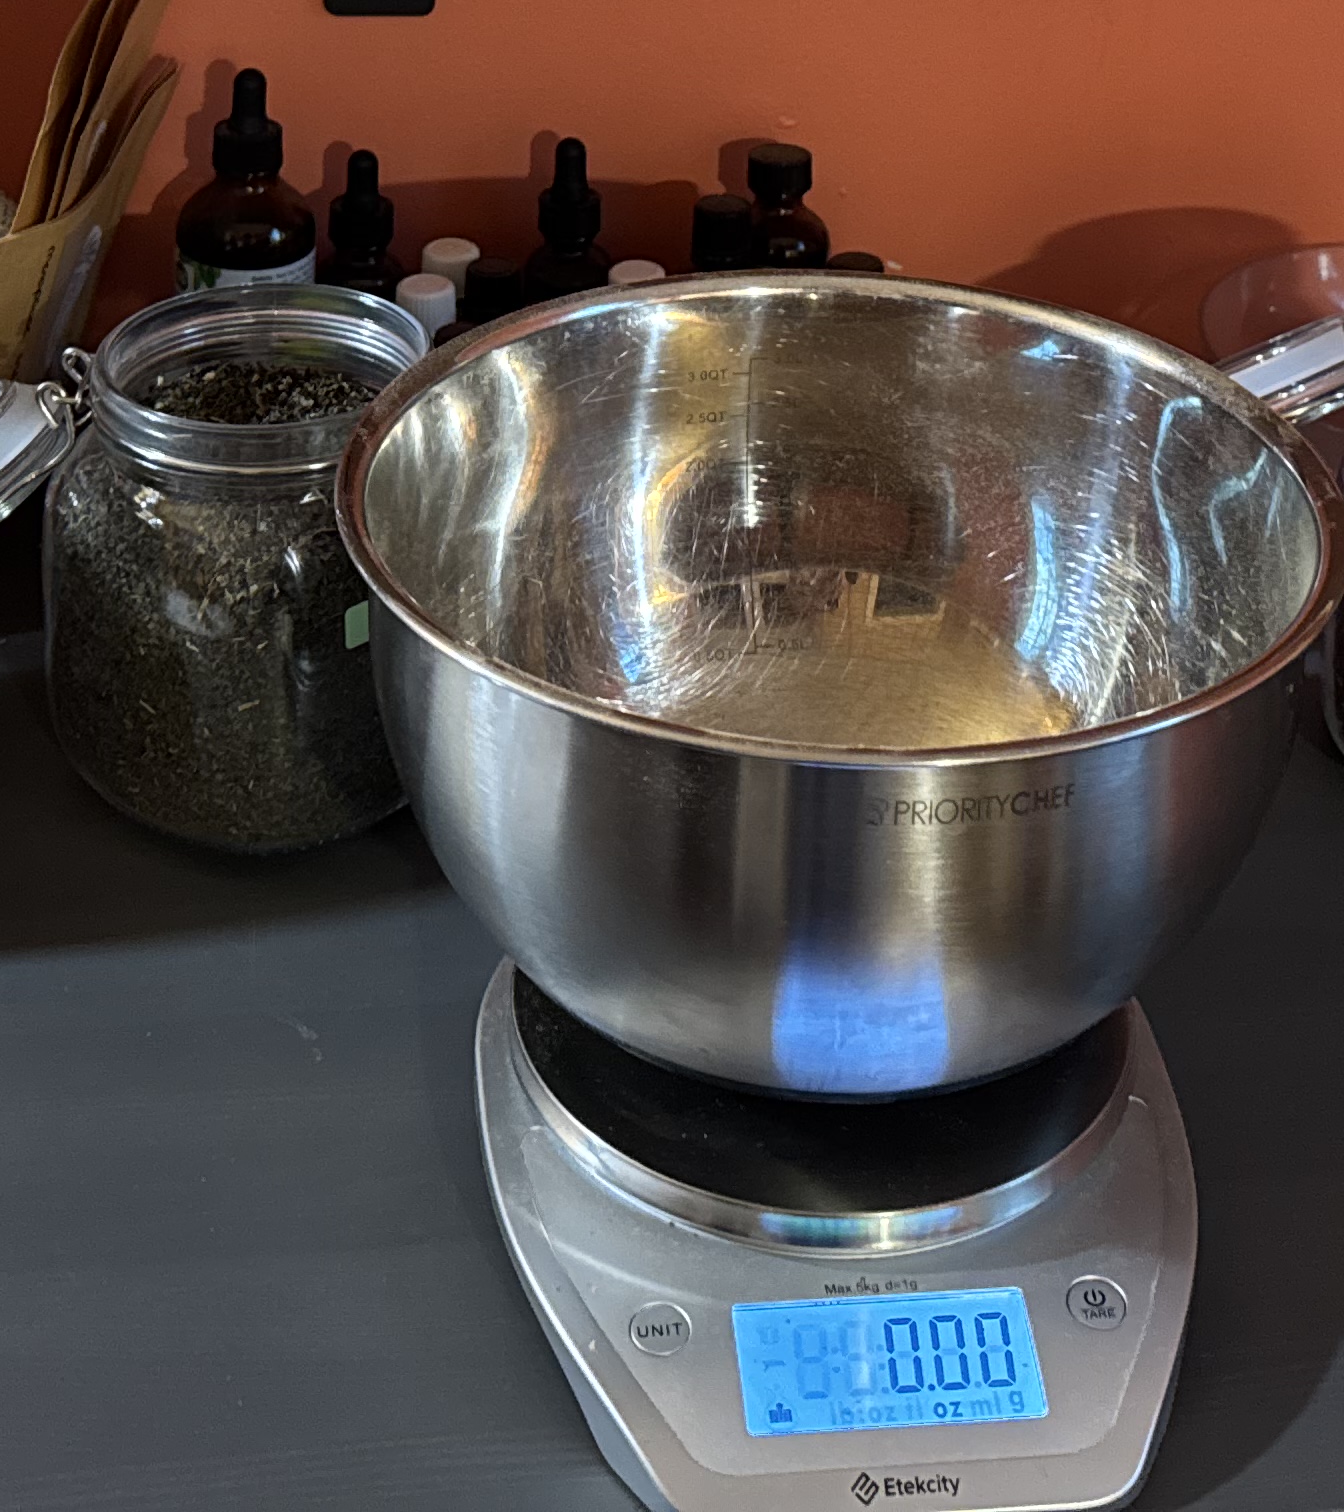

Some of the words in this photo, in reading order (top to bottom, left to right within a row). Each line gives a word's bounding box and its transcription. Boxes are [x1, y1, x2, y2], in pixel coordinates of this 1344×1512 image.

[892, 784, 1074, 826] PRIORITYCHEF
[824, 1282, 852, 1296] Max
[1080, 1306, 1117, 1320] TARE
[637, 1322, 684, 1339] UNIT
[883, 1310, 1018, 1394] 0.00
[933, 1401, 964, 1419] oz
[883, 1473, 960, 1497] Etekcity
